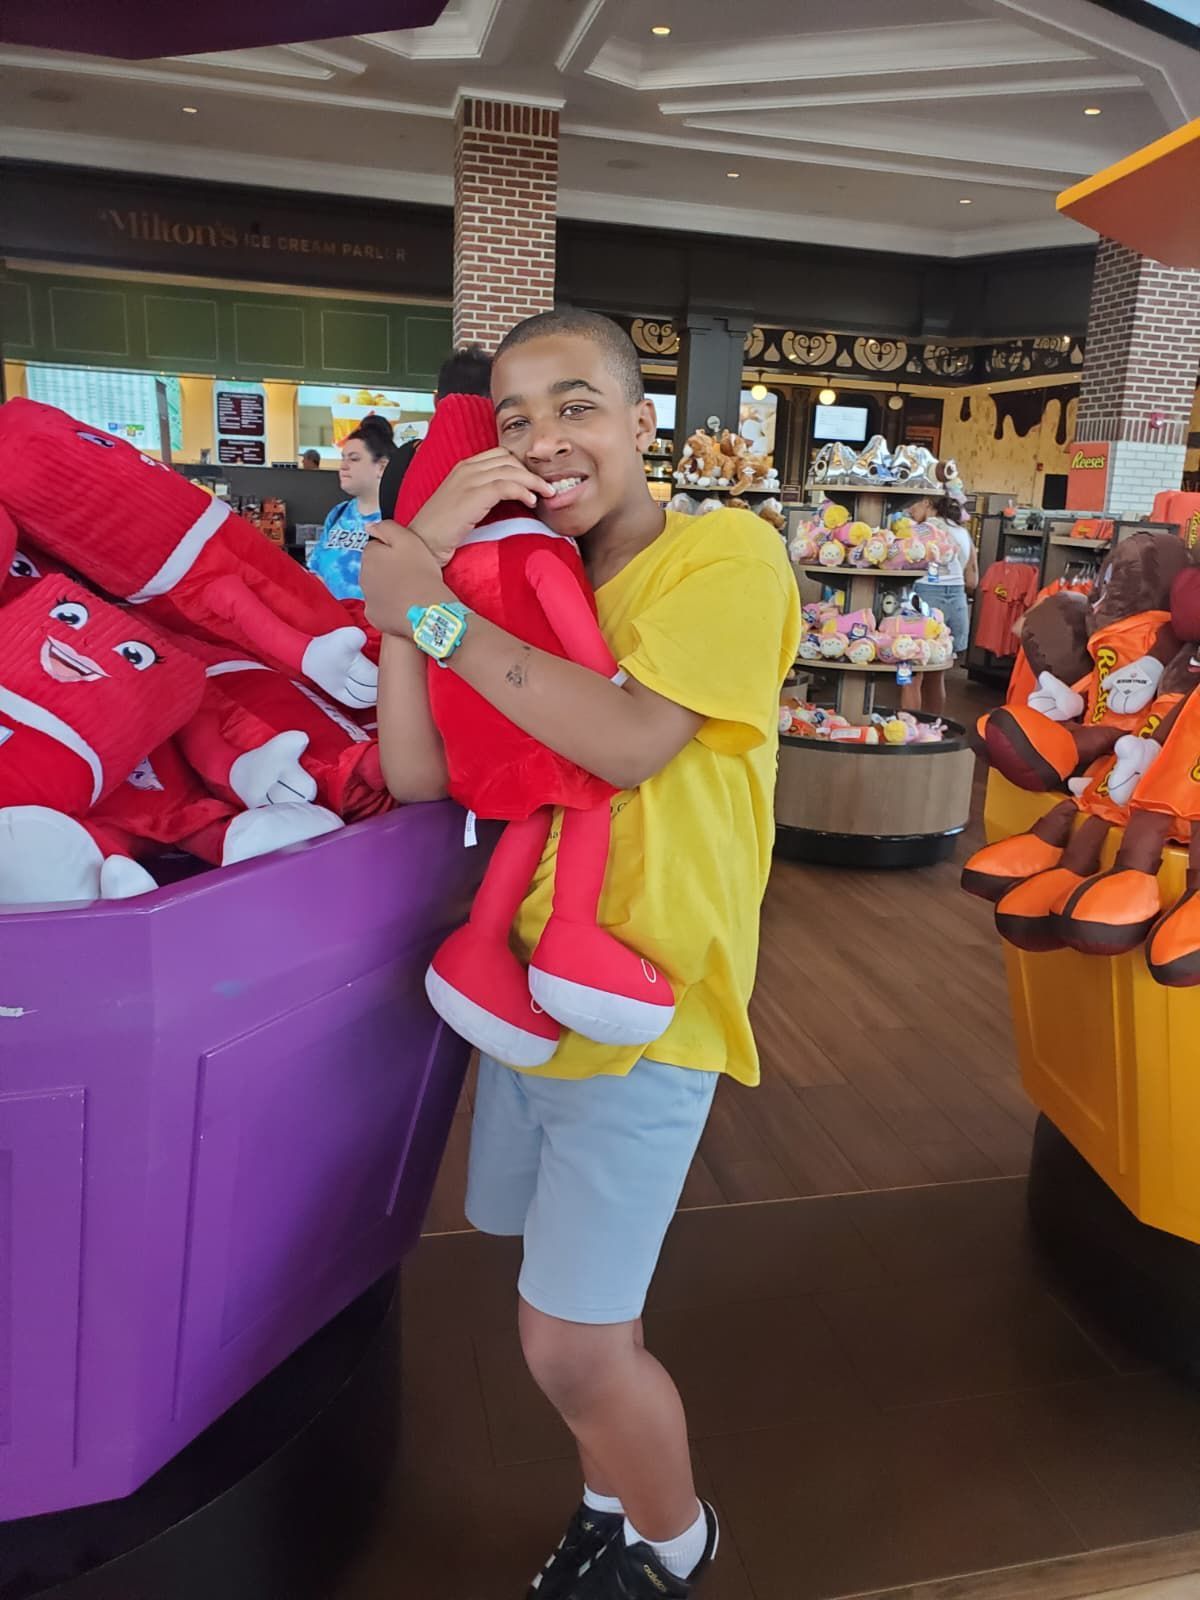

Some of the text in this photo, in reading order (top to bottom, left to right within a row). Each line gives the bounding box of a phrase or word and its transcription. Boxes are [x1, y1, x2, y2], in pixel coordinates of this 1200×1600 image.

[98, 208, 406, 262] Milton's ICE CREAM PARLR
